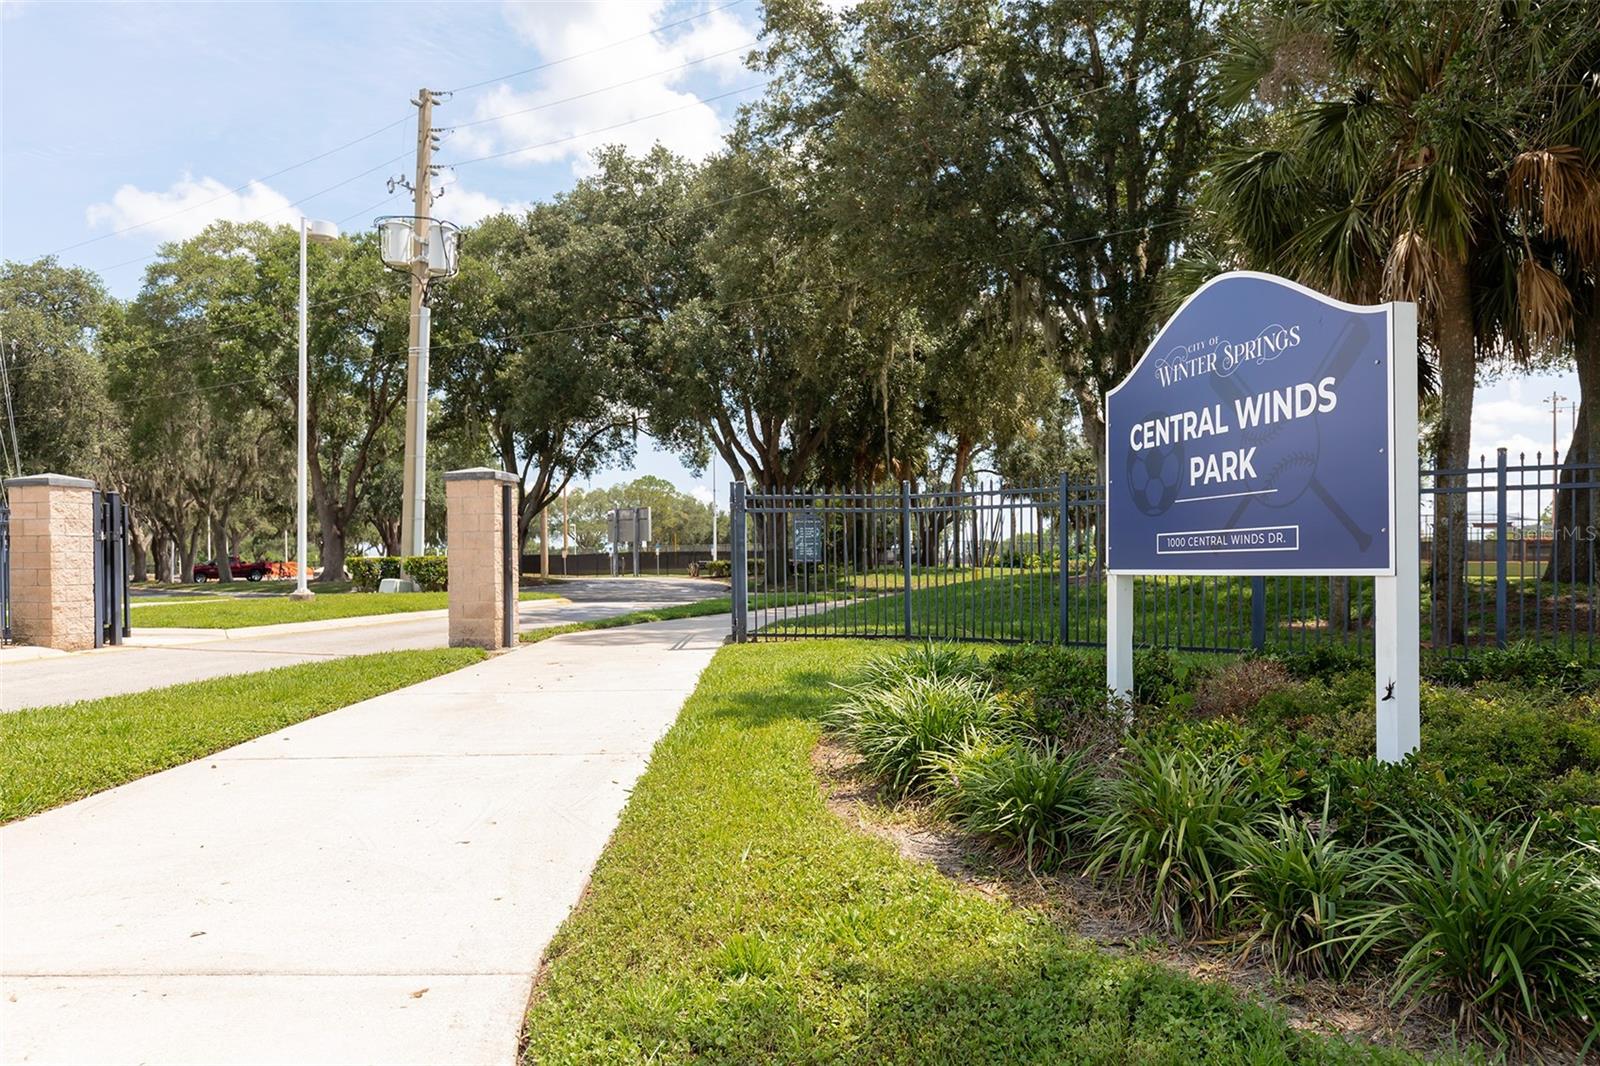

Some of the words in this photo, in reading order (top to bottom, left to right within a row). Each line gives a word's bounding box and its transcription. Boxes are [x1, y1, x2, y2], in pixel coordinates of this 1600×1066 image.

[1155, 349, 1218, 388] WINTER
[1218, 325, 1301, 373] SPRINGS
[1187, 340, 1206, 354] CITY
[1208, 335, 1221, 347] OF
[1129, 404, 1229, 452] CENTRAL
[1234, 376, 1338, 430] WINDS
[1189, 446, 1258, 487] PARK
[1167, 537, 1186, 548] 1000
[1187, 534, 1228, 547] CENTRAL
[1230, 532, 1265, 545] WINDS
[1268, 531, 1287, 544] DR.
